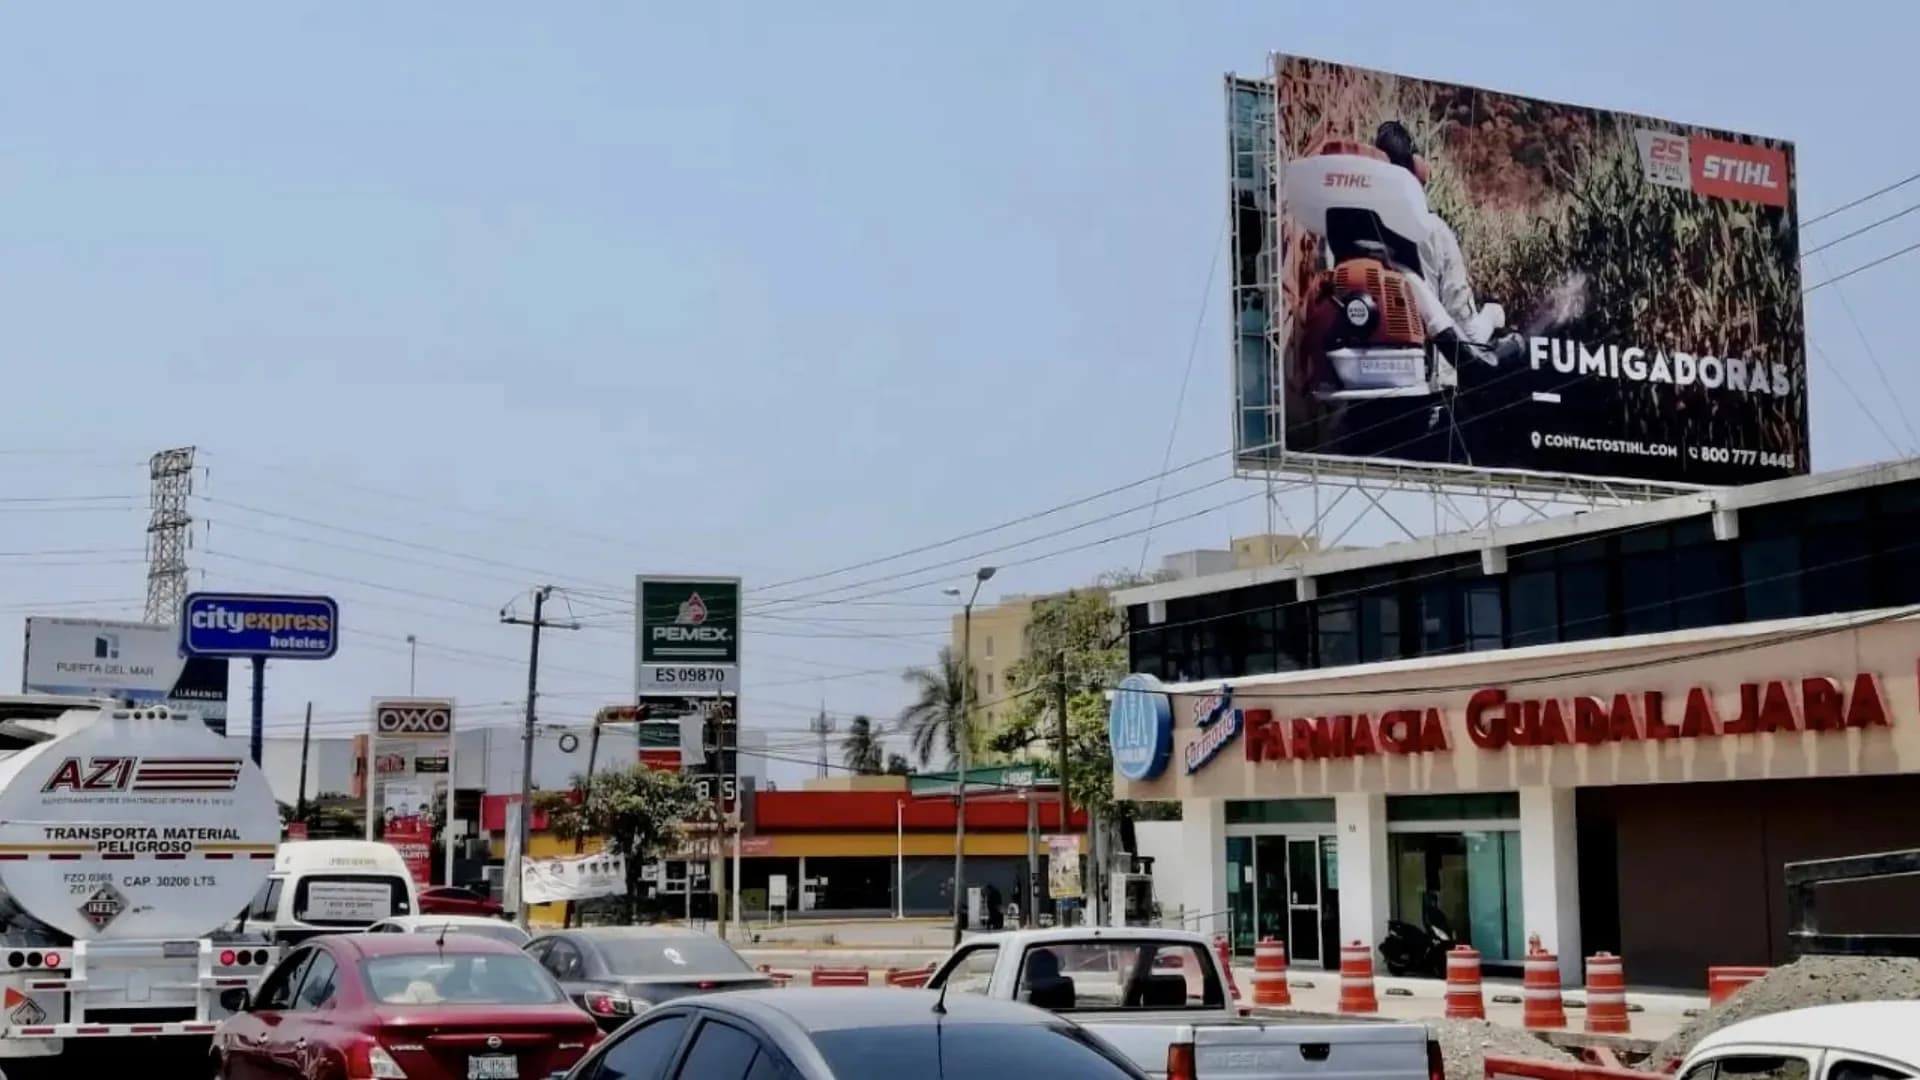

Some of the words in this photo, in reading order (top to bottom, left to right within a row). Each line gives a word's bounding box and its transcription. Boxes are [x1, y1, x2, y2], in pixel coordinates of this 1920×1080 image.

[1651, 138, 1684, 162] 25
[1324, 173, 1371, 188] STIHL
[1703, 155, 1778, 188] STIHL
[1529, 336, 1791, 396] FUMIGADORAS
[1544, 434, 1678, 457] CONTACTOSTIHL.COM
[1701, 447, 1729, 463] 800
[1732, 449, 1756, 465] 777
[1759, 451, 1796, 469] 8445
[192, 604, 330, 635] cityexpress
[269, 636, 327, 649] hoteles
[652, 626, 729, 641] PEMEX
[56, 662, 101, 673] PUERTA
[105, 663, 125, 674] DEL
[129, 664, 155, 676] MAR
[655, 667, 676, 682] ES
[678, 668, 725, 682] 09870
[379, 709, 449, 731] OXXO
[41, 756, 137, 792] AZI
[44, 827, 158, 840] TRANSPORTA
[163, 827, 240, 841] MATERIAL
[97, 840, 193, 853] PELIGROSO
[156, 876, 190, 887] 30200
